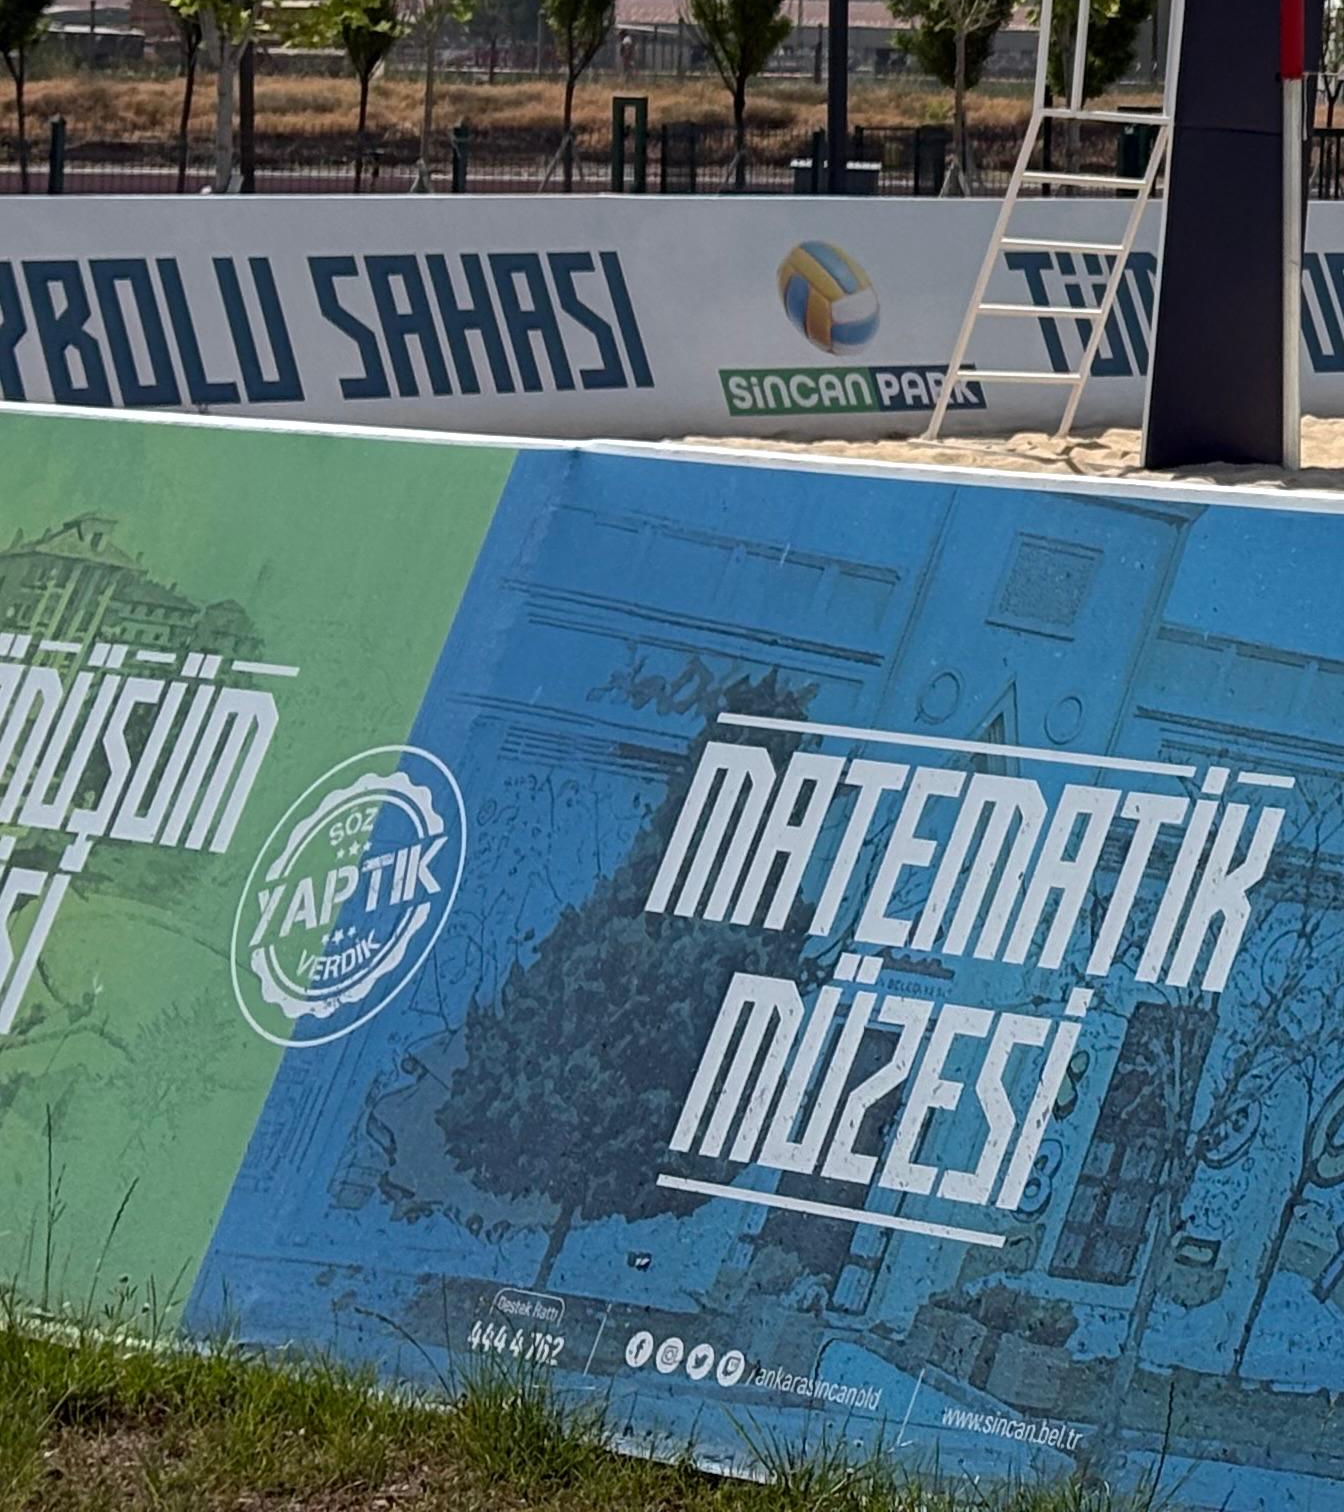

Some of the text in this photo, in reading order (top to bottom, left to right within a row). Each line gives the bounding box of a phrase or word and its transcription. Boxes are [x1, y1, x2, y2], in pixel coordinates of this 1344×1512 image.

[307, 251, 655, 400] SAHASI
[329, 805, 380, 846] SÖZ
[644, 739, 1287, 993] MATEMATİK
[248, 835, 449, 948] YAPTIK
[296, 927, 383, 982] VERDİK
[668, 952, 1095, 1211] MÜZESİ
[941, 1404, 1085, 1453] www.sincan.bel.tr
